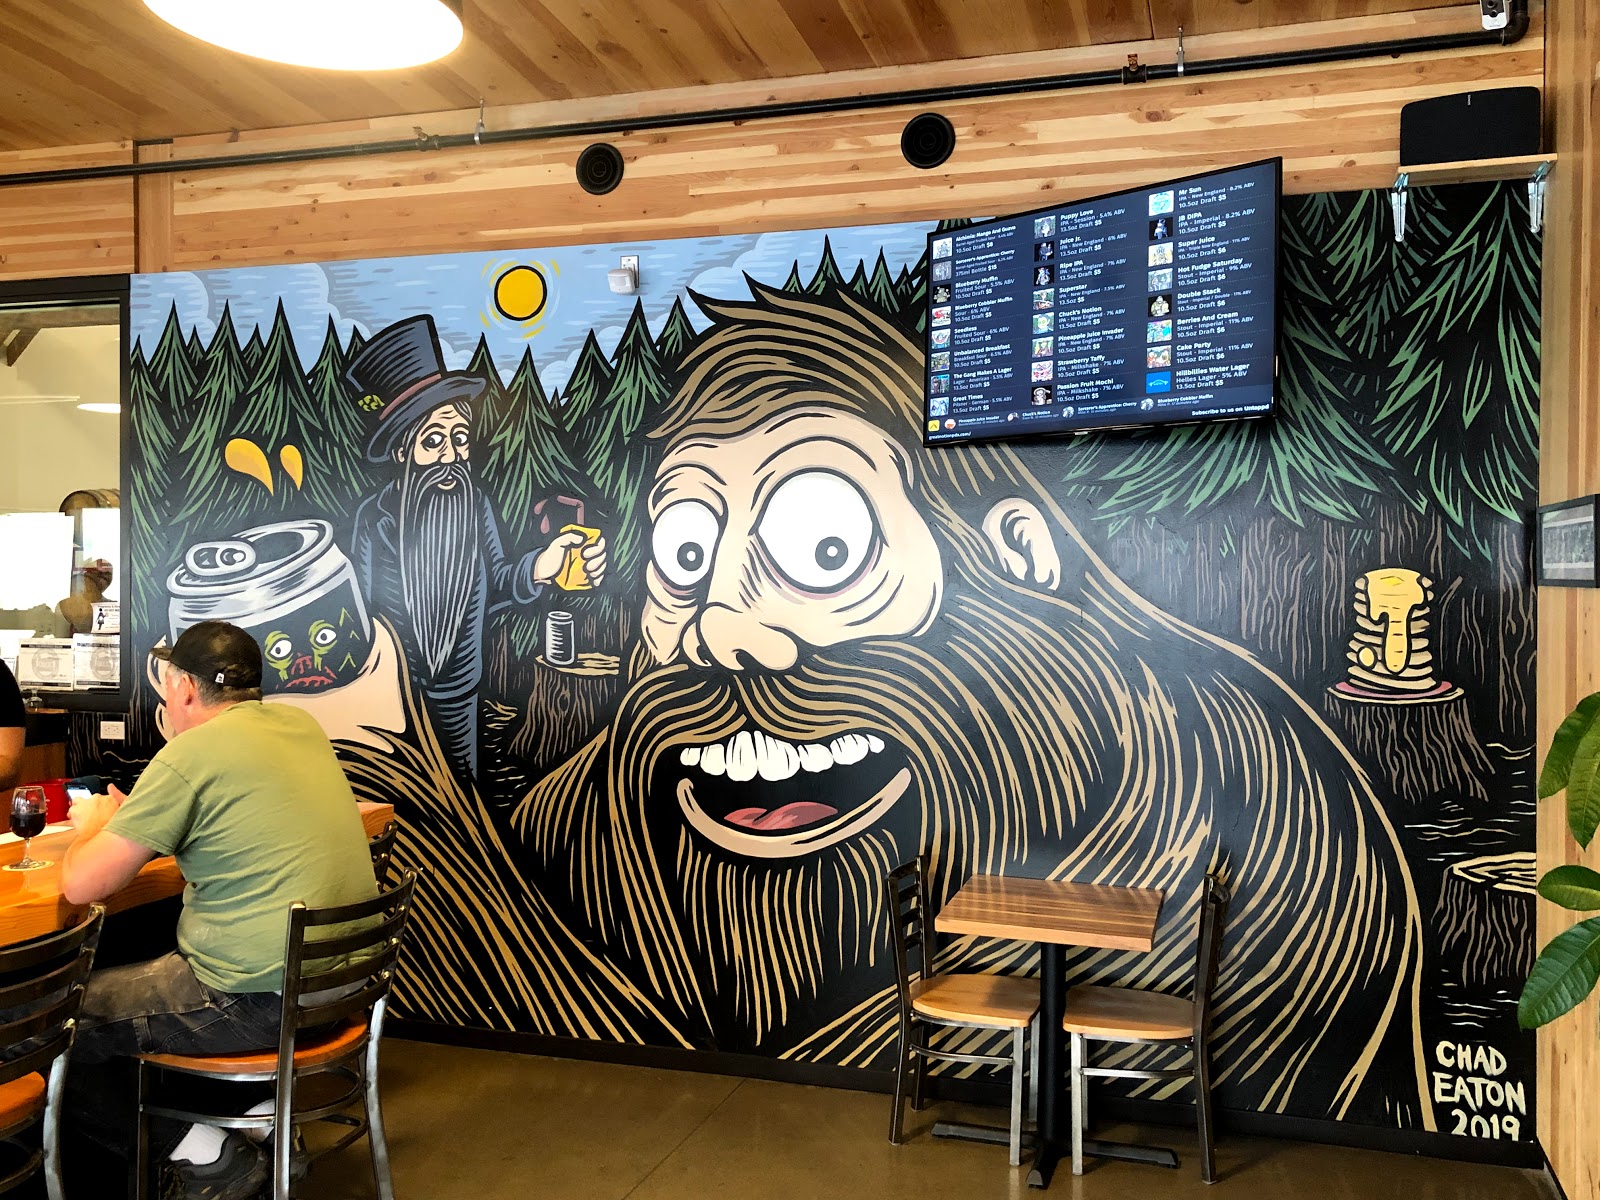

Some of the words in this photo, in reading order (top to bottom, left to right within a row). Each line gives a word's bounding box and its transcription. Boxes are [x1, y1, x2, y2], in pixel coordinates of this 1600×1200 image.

[1204, 188, 1225, 196] England
[1200, 196, 1217, 204] Draft
[1187, 212, 1202, 220] DIPA
[1194, 215, 1220, 225] Imperial
[1079, 221, 1093, 229] Draft
[1178, 240, 1198, 248] Super
[1200, 249, 1216, 257] Draft
[1191, 263, 1211, 271] Fudge
[1212, 258, 1243, 268] Saturday
[1199, 267, 1224, 276] Imperial
[1200, 275, 1216, 283] Draft
[1217, 273, 1226, 281] $6
[955, 280, 981, 288] Blueberry
[1059, 284, 1087, 293] Superstar
[1178, 291, 1201, 299] Double
[1202, 287, 1221, 296] Stack
[1199, 301, 1215, 309] Draft
[1177, 317, 1201, 325] Berries
[1217, 312, 1238, 320] Cream
[1199, 320, 1223, 328] Imperial
[954, 326, 977, 334] Seedless
[1058, 333, 1086, 341] Pineapple
[985, 344, 1010, 352] Breakfast
[1058, 358, 1089, 366] Strawberry
[1176, 368, 1208, 377] Hillbillies
[1197, 380, 1214, 388] Draft
[1436, 1041, 1507, 1076] CHAD
[1433, 1071, 1527, 1116] EATON
[1451, 1109, 1520, 1141] 2019
